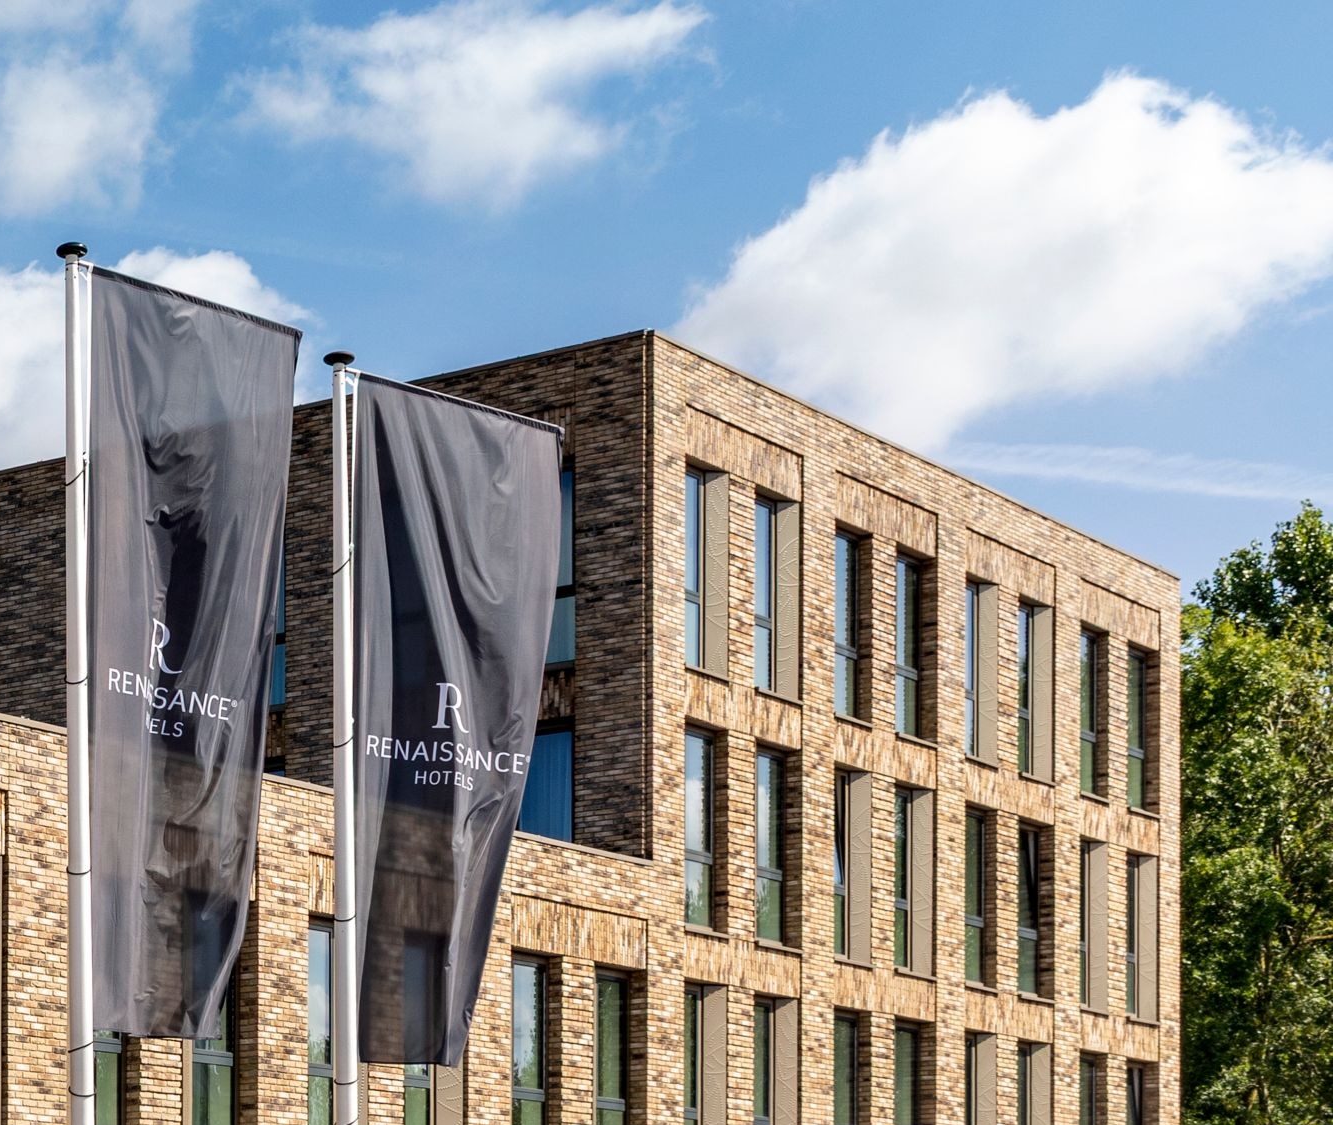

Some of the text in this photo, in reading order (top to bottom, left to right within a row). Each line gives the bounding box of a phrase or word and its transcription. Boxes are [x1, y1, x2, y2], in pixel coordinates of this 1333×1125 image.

[149, 618, 183, 675] R
[431, 682, 469, 734] R
[414, 770, 474, 791] HOTELS
